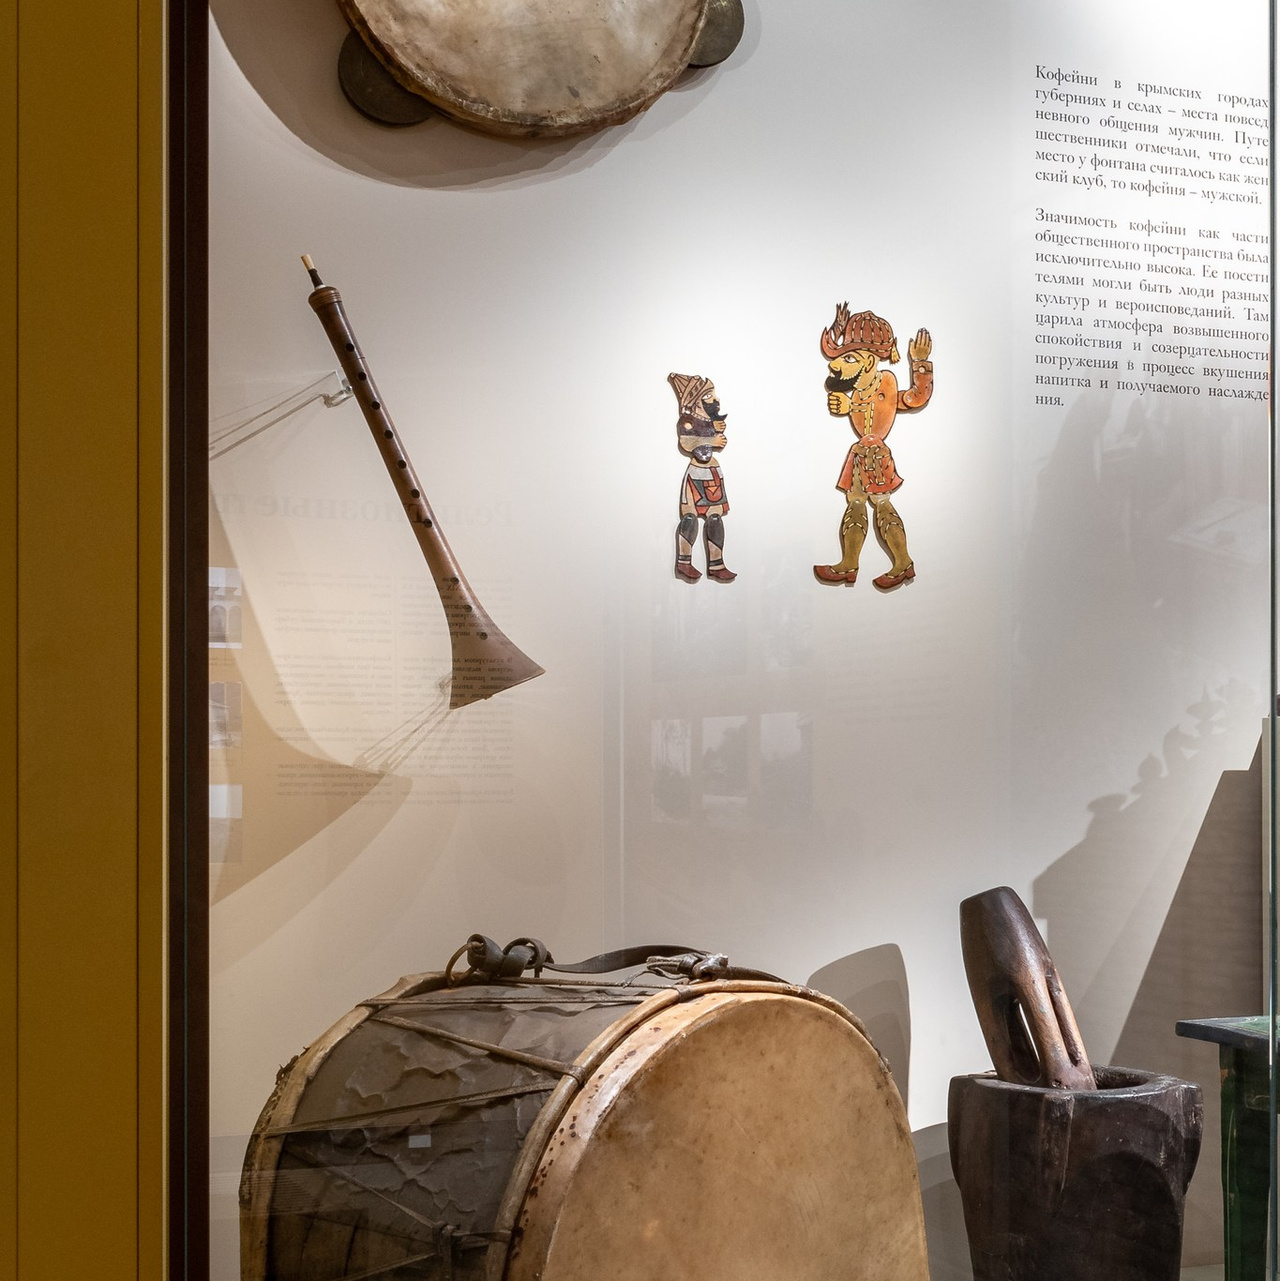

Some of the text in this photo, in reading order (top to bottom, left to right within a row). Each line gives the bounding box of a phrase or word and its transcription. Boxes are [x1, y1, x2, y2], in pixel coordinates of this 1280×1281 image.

[1035, 64, 1098, 87] Кофейни
[1114, 79, 1122, 89] в
[1137, 82, 1202, 100] крымских
[1035, 150, 1075, 164] место
[1078, 155, 1087, 170] у
[1090, 152, 1146, 172] фонтана
[1149, 164, 1216, 180] считалось
[1218, 172, 1240, 183] как
[1035, 169, 1068, 184] ский
[1072, 173, 1107, 189] клуб,
[1110, 179, 1127, 190] то
[1130, 179, 1186, 198] кофейня
[1201, 189, 1262, 205] мужской.
[1034, 229, 1269, 264] общественного пространства была
[1035, 293, 1269, 322] культур и вероисповеданий. Там
[1035, 313, 1269, 342] царила атмосфера возвышенного
